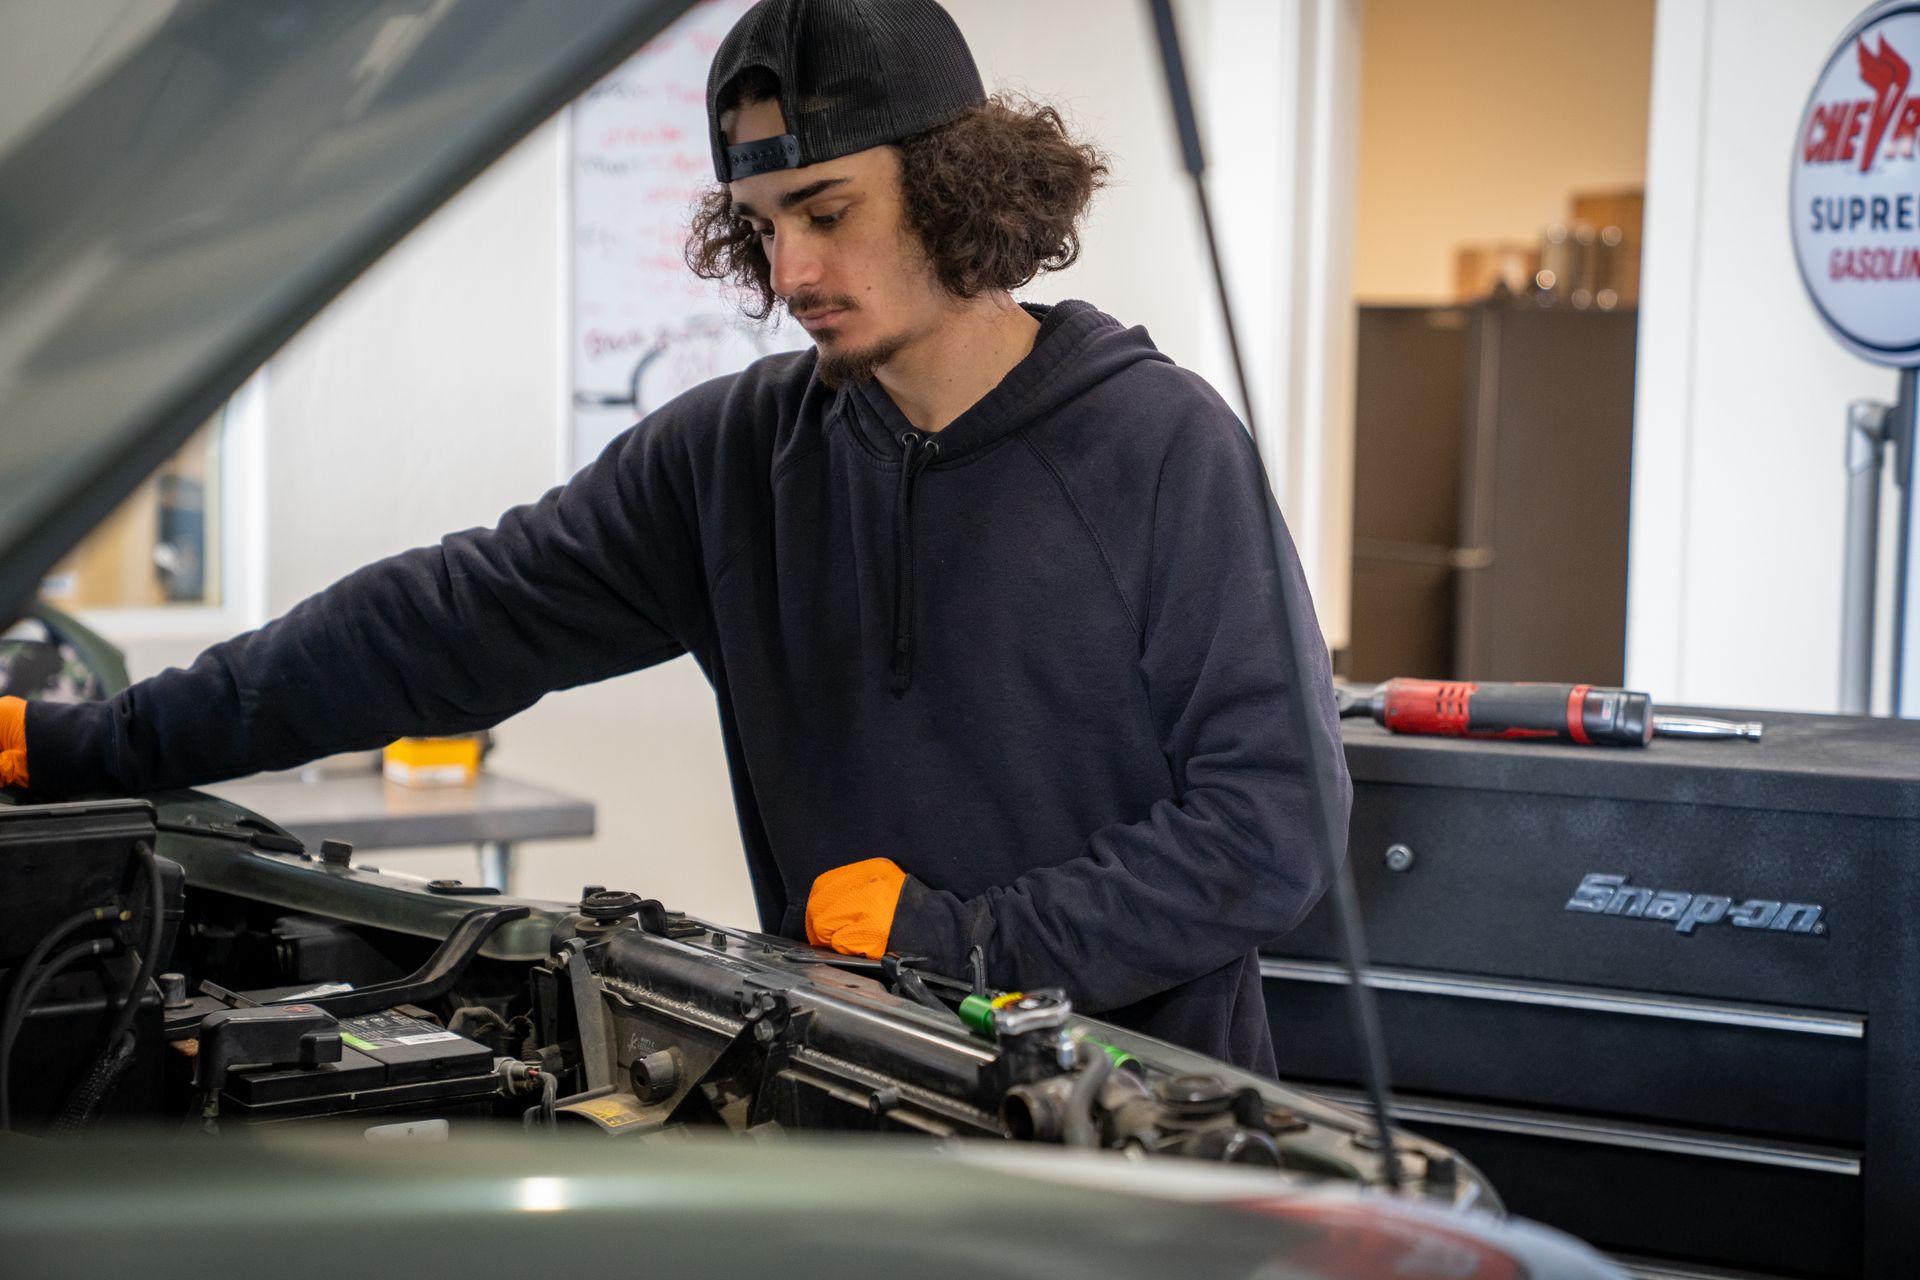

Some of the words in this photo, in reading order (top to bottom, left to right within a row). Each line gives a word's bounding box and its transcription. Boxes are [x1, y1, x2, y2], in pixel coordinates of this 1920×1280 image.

[1803, 93, 1920, 174] CHEVR
[1810, 193, 1920, 232] SUPRE
[1565, 873, 1823, 933] Snap-on
